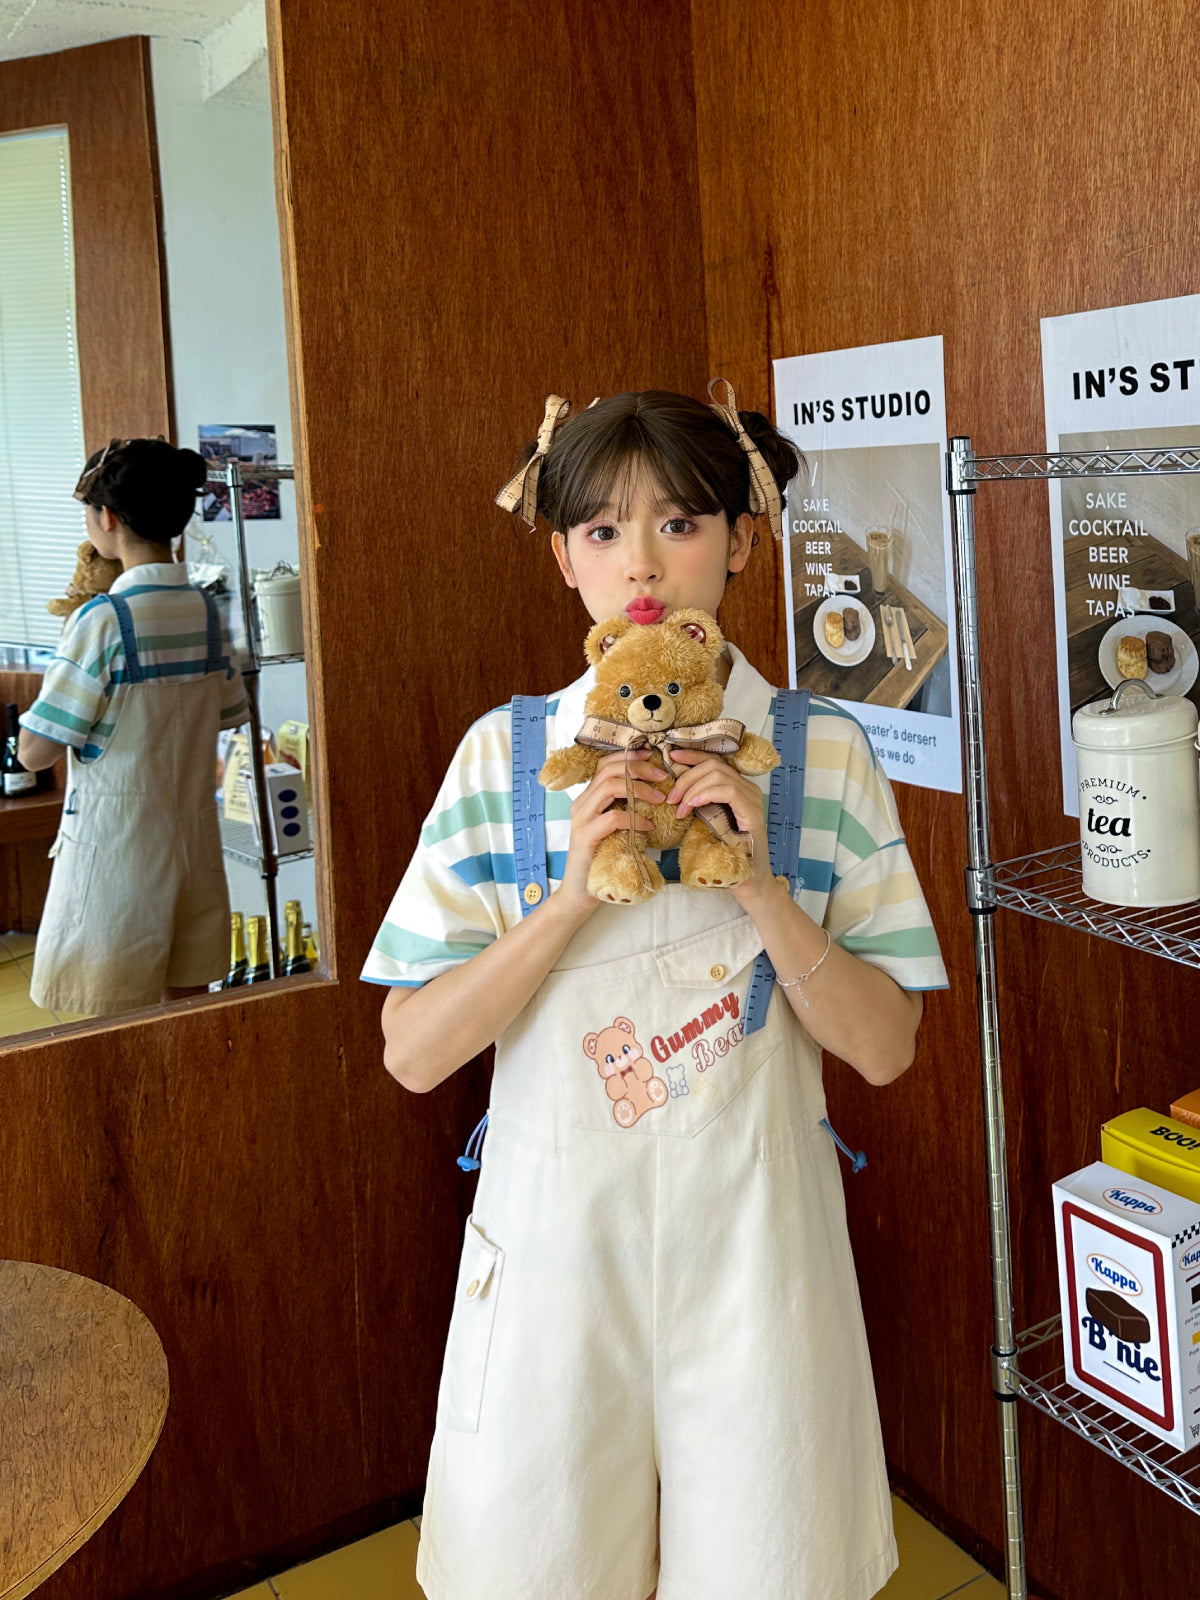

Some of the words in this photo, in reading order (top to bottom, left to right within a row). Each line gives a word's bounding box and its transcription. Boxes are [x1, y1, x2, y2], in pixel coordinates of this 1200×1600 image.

[1073, 366, 1139, 400] IN’S
[1150, 359, 1200, 393] ST
[793, 399, 835, 425] IN’S
[841, 389, 931, 421] STUDIO
[803, 498, 829, 512] SAKE
[1086, 492, 1127, 509] SAKE
[793, 519, 843, 533] COCKTAIL
[1069, 519, 1149, 537] COCKTAIL
[805, 541, 831, 555] BEER
[1089, 546, 1129, 563] BEER
[805, 562, 833, 576] WINE
[804, 583, 836, 598] TAPAS
[1088, 573, 1131, 590] WINE
[1086, 599, 1135, 618] TAPAS
[863, 724, 899, 740] eater’s
[901, 729, 937, 747] dersert
[875, 746, 885, 758] as
[887, 749, 900, 762] we
[903, 750, 915, 765] do
[1080, 777, 1141, 798] PREMIUM
[1087, 808, 1132, 837] tea
[1083, 844, 1149, 868] PRODUCTS
[650, 991, 740, 1063] Gummy
[1108, 1189, 1157, 1213] Kappa
[1091, 1256, 1139, 1293] Kappa
